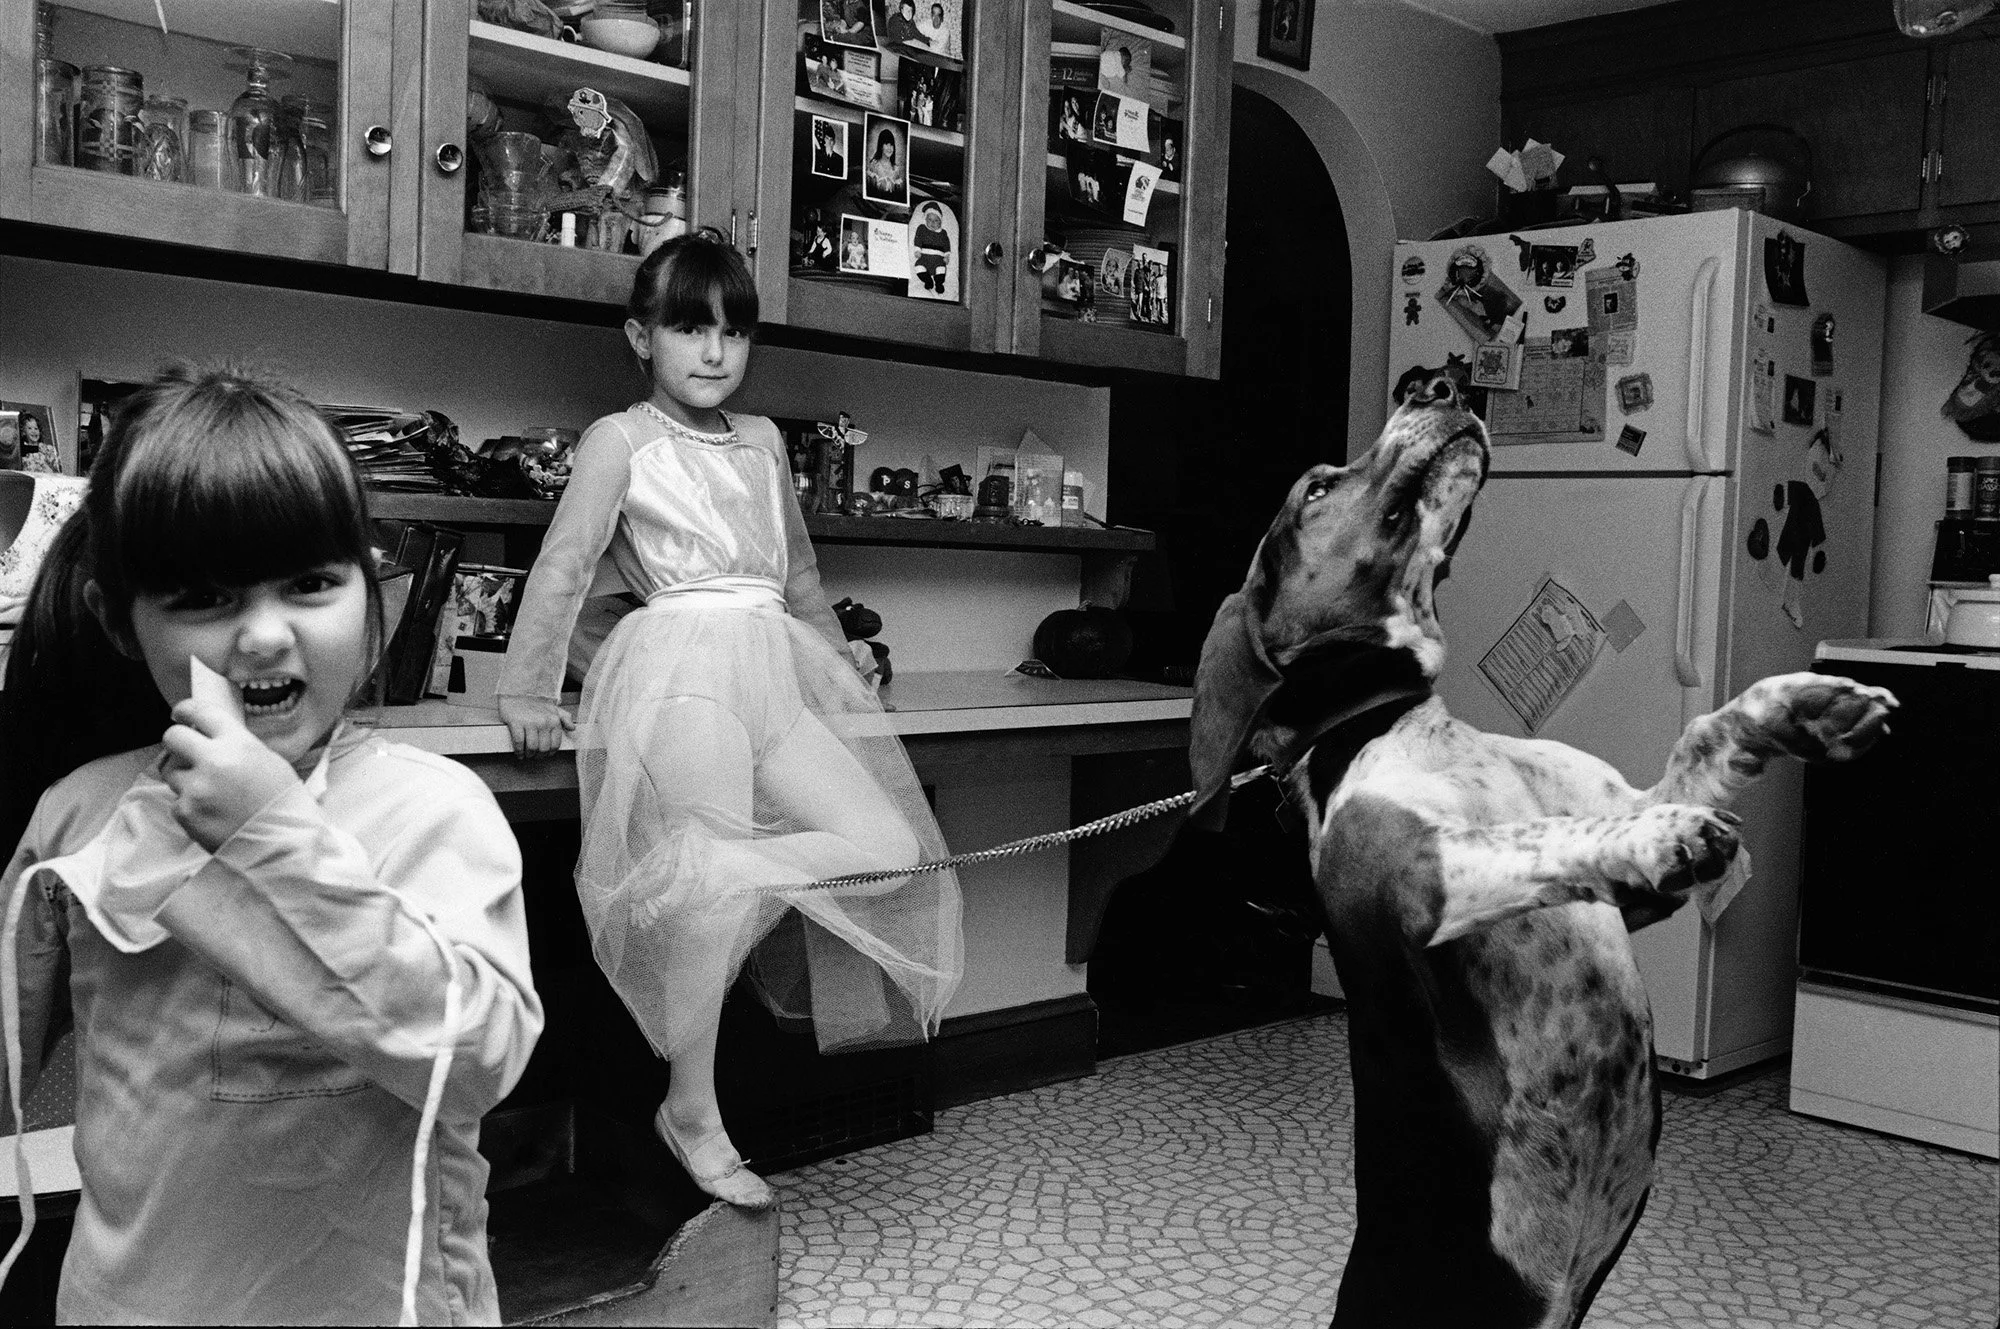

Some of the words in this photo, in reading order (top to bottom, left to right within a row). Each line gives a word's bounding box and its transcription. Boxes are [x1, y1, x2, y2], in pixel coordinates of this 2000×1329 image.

[1062, 67, 1073, 80] 12
[881, 474, 891, 486] P
[903, 480, 911, 489] S
